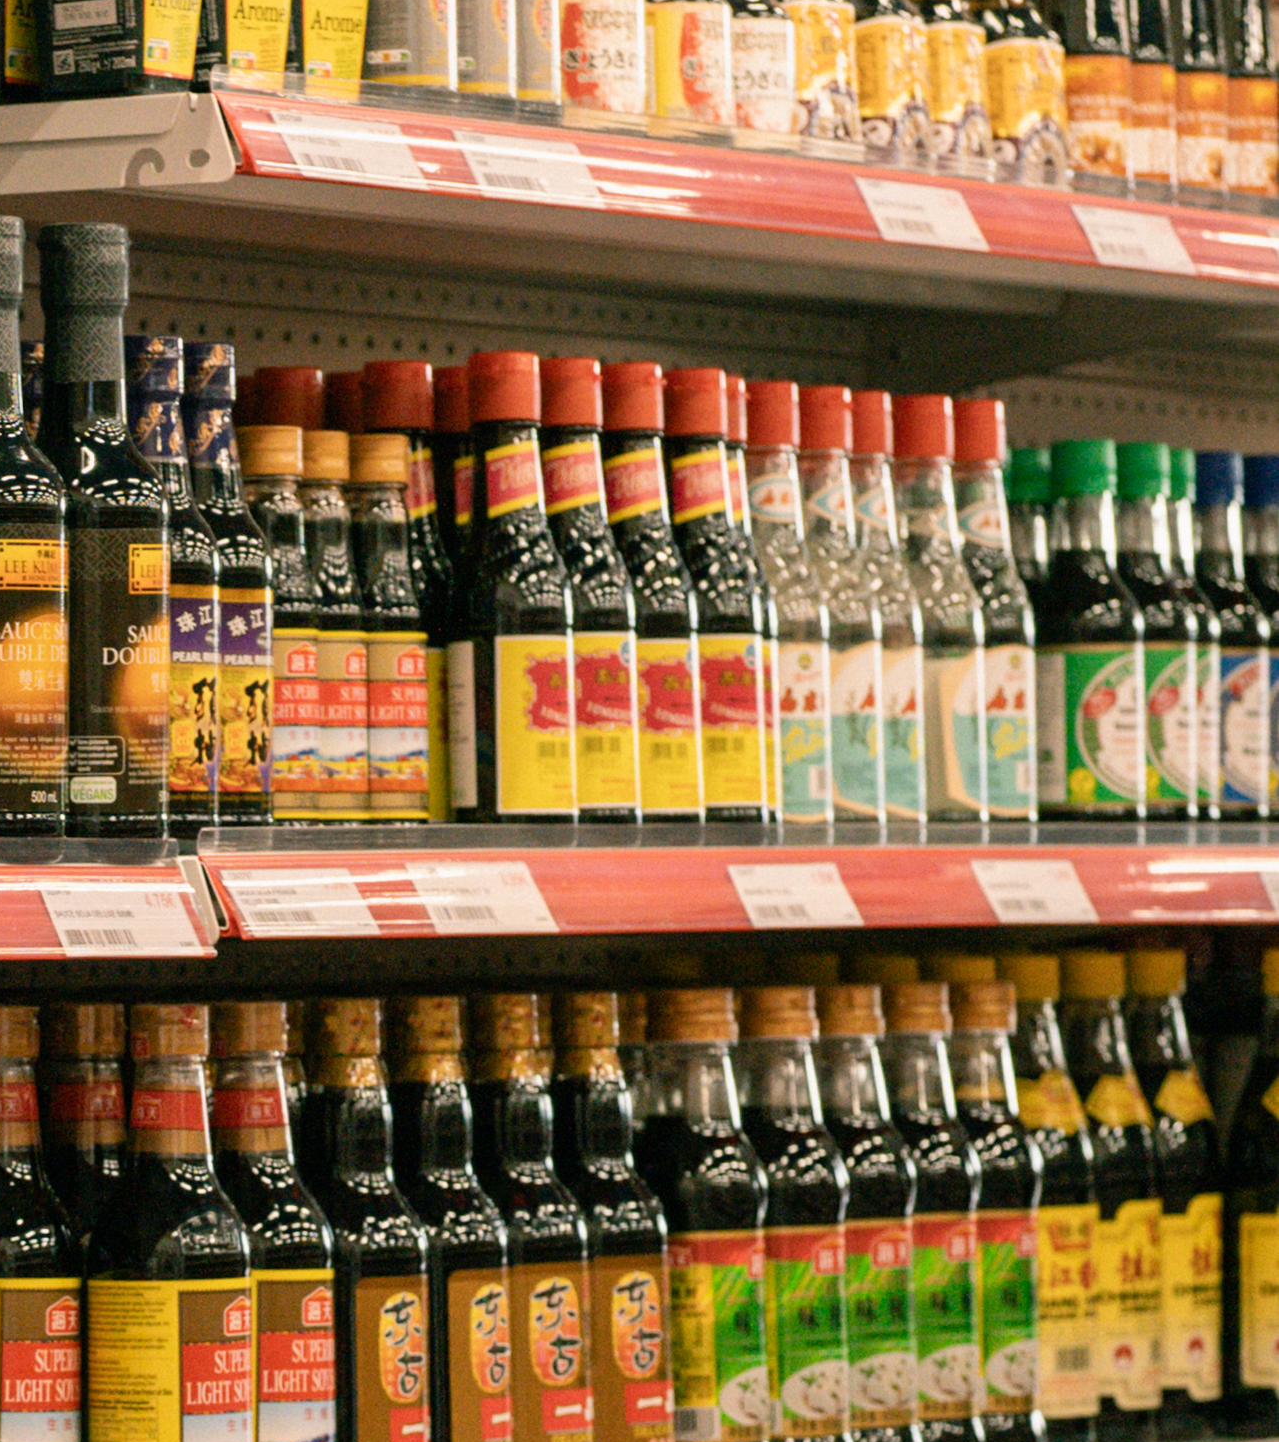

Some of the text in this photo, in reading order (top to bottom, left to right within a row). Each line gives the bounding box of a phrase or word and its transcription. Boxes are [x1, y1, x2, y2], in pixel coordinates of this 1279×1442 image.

[234, 0, 285, 22] Arome
[310, 11, 362, 33] Arome
[4, 560, 27, 574] LEE
[4, 1380, 51, 1404] LIGHT
